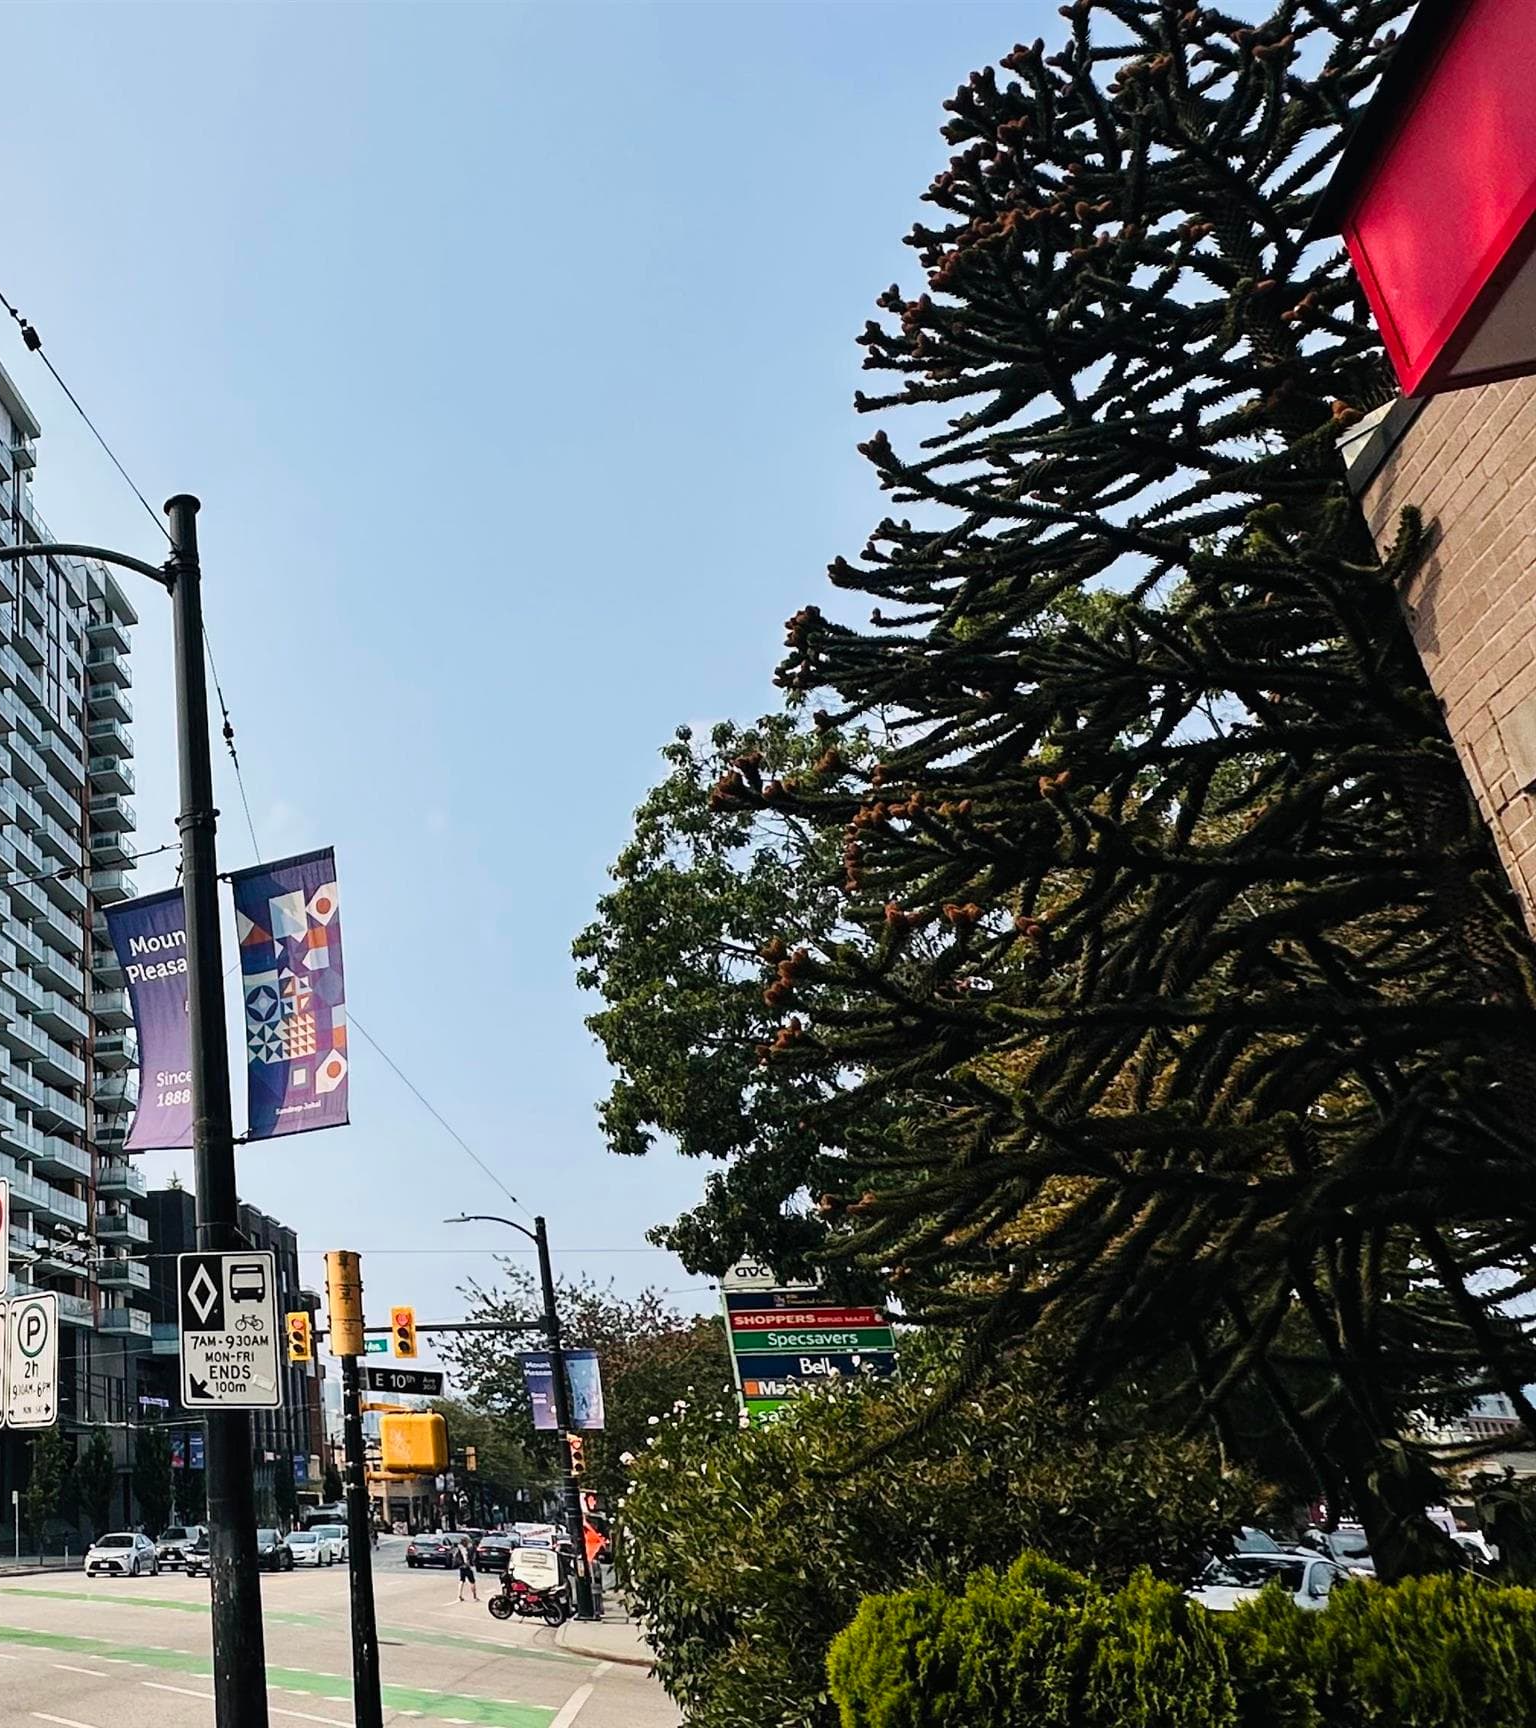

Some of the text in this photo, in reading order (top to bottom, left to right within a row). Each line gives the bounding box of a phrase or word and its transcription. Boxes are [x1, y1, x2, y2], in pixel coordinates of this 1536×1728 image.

[128, 929, 186, 957] Moun
[125, 957, 188, 984] Pleasa
[156, 1070, 192, 1087] Since
[156, 1088, 191, 1107] 1888
[733, 1314, 816, 1325] SHOPPERS
[767, 1333, 859, 1348] Specsavers
[205, 1351, 255, 1362] MON-FRI
[24, 1360, 39, 1379] 2h
[209, 1365, 251, 1379] ENDS
[799, 1357, 831, 1375] Bell
[215, 1381, 246, 1393] 100m
[375, 1373, 416, 1388] E 10th
